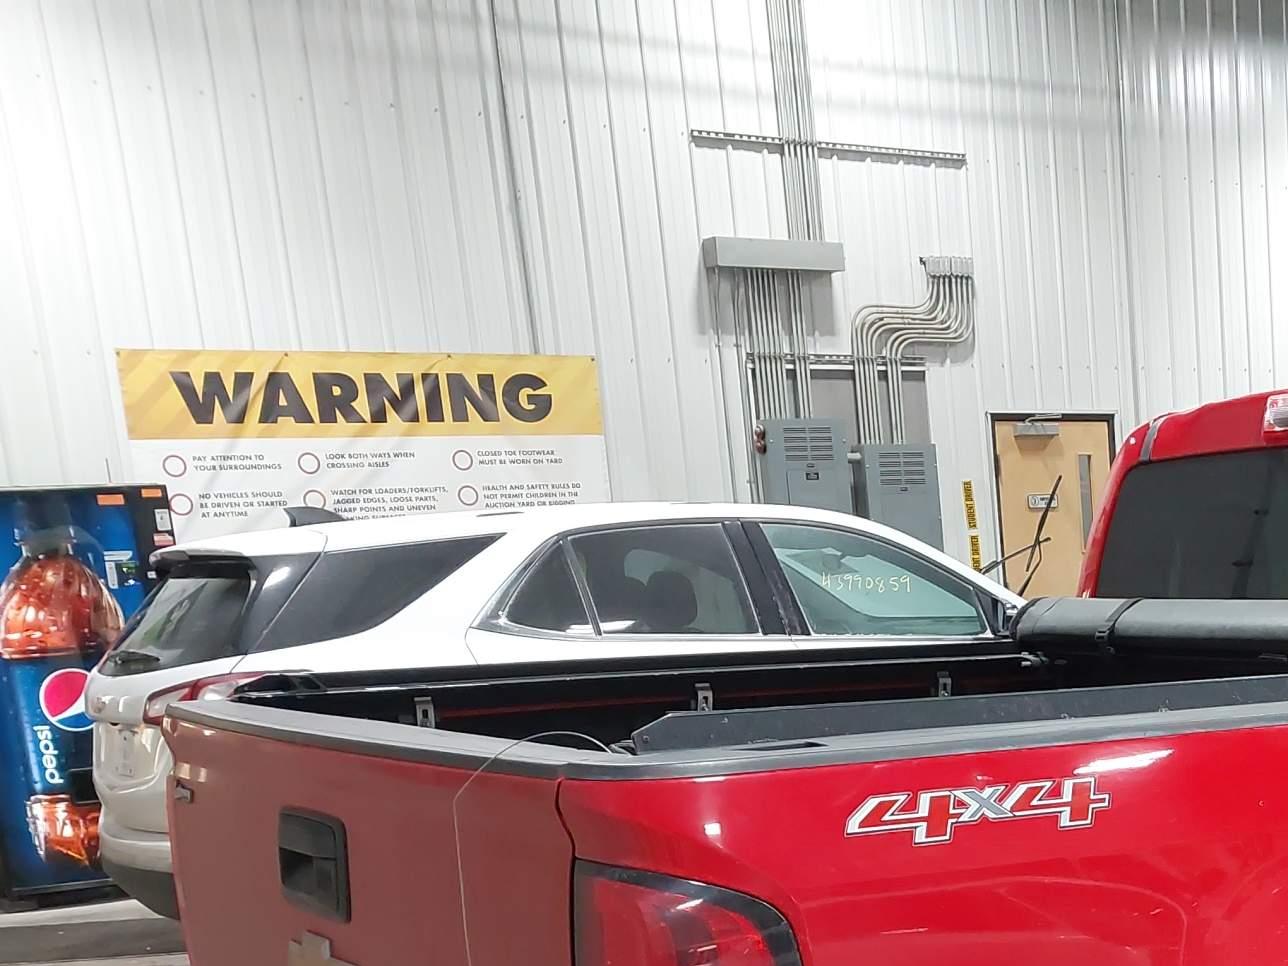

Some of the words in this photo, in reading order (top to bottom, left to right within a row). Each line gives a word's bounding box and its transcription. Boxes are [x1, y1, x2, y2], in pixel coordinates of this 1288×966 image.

[169, 371, 553, 424] WARNING
[194, 464, 217, 472] YOUR
[219, 463, 282, 471] SURROUNDINGS
[963, 480, 974, 503] DRIVER
[966, 502, 977, 529] STUDENT
[970, 535, 979, 556] DRIVER
[33, 725, 64, 784] pepsi
